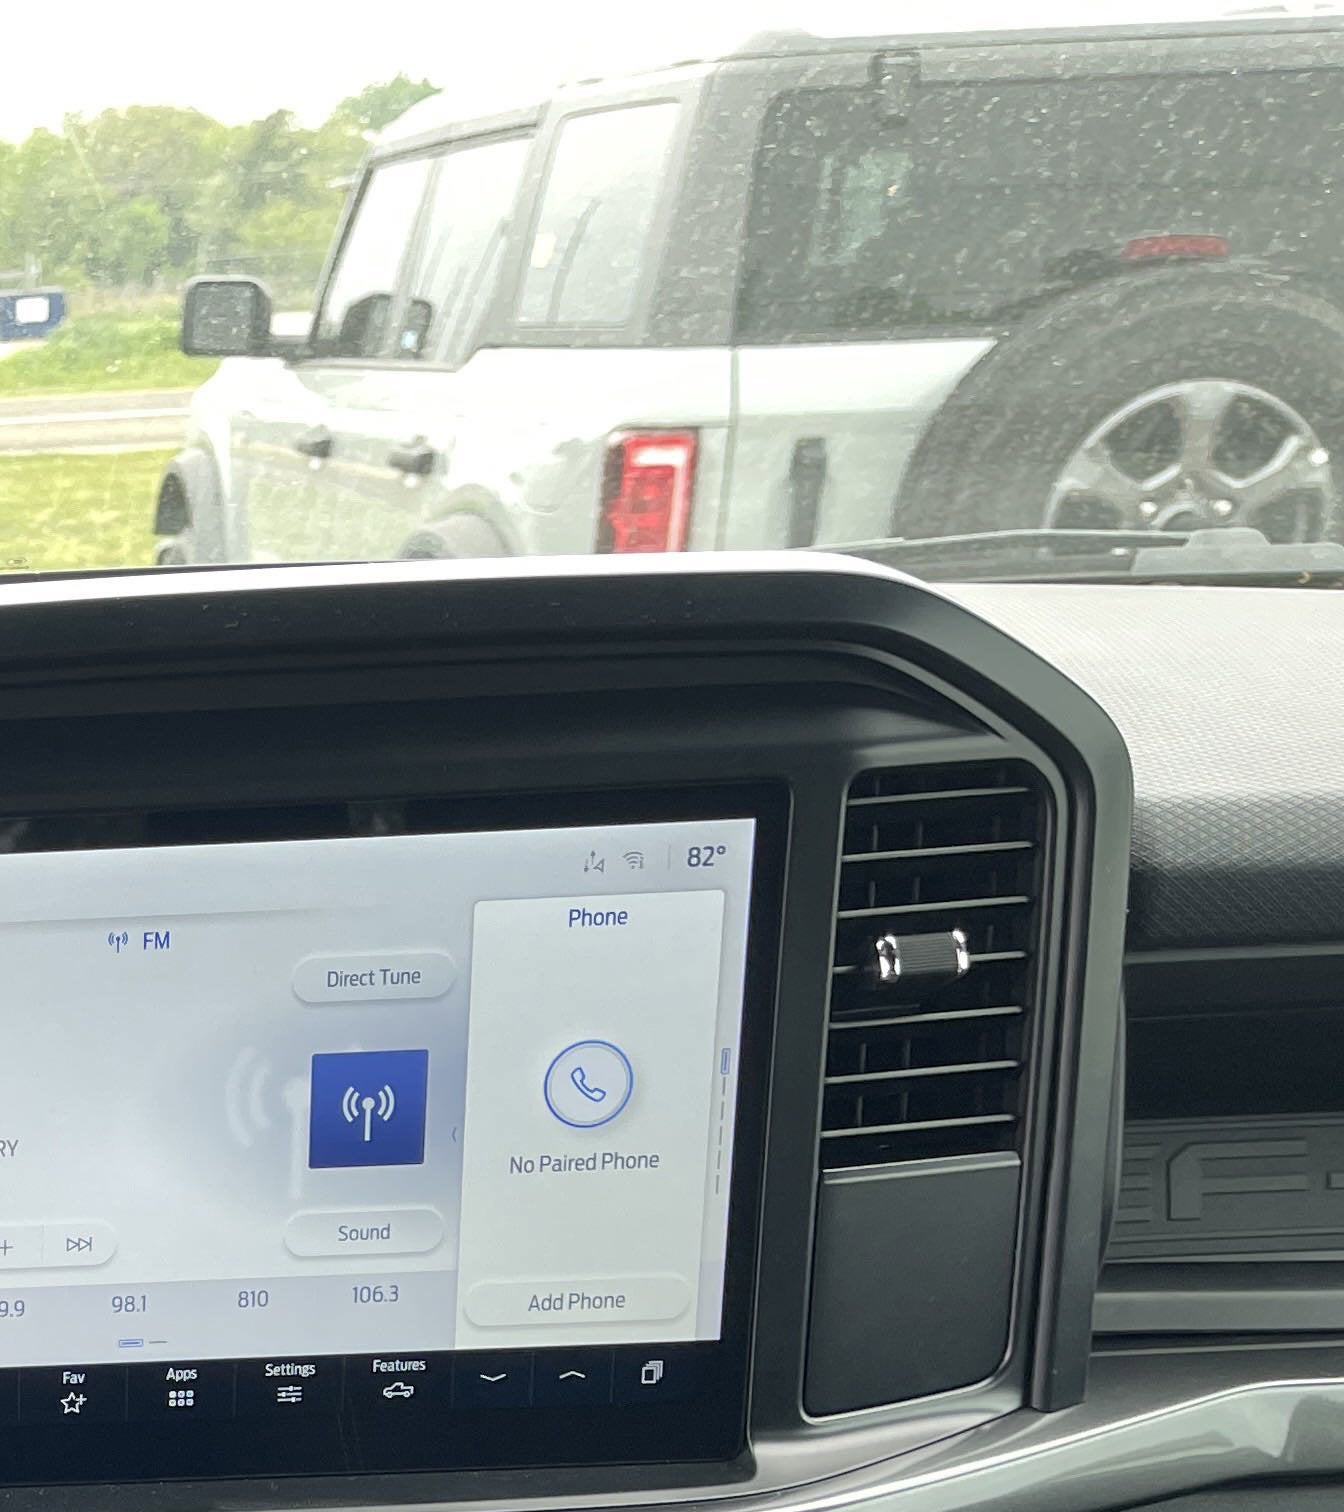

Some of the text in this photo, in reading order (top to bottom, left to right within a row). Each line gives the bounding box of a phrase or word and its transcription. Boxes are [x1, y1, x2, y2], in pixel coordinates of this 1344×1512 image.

[686, 845, 727, 868] 82°
[568, 907, 629, 928] Phone
[143, 931, 170, 951] FM
[327, 967, 422, 988] Direct Tune
[509, 1150, 660, 1174] No Paired Phone
[337, 1222, 391, 1242] Sound
[237, 1290, 269, 1309] 810
[351, 1285, 400, 1304] 106.3
[527, 1290, 626, 1313] Add Phone
[111, 1295, 148, 1314] 98.1
[265, 1361, 316, 1379] Settings
[372, 1358, 426, 1374] Features
[62, 1370, 86, 1385] Fav
[166, 1367, 198, 1385] Apps
